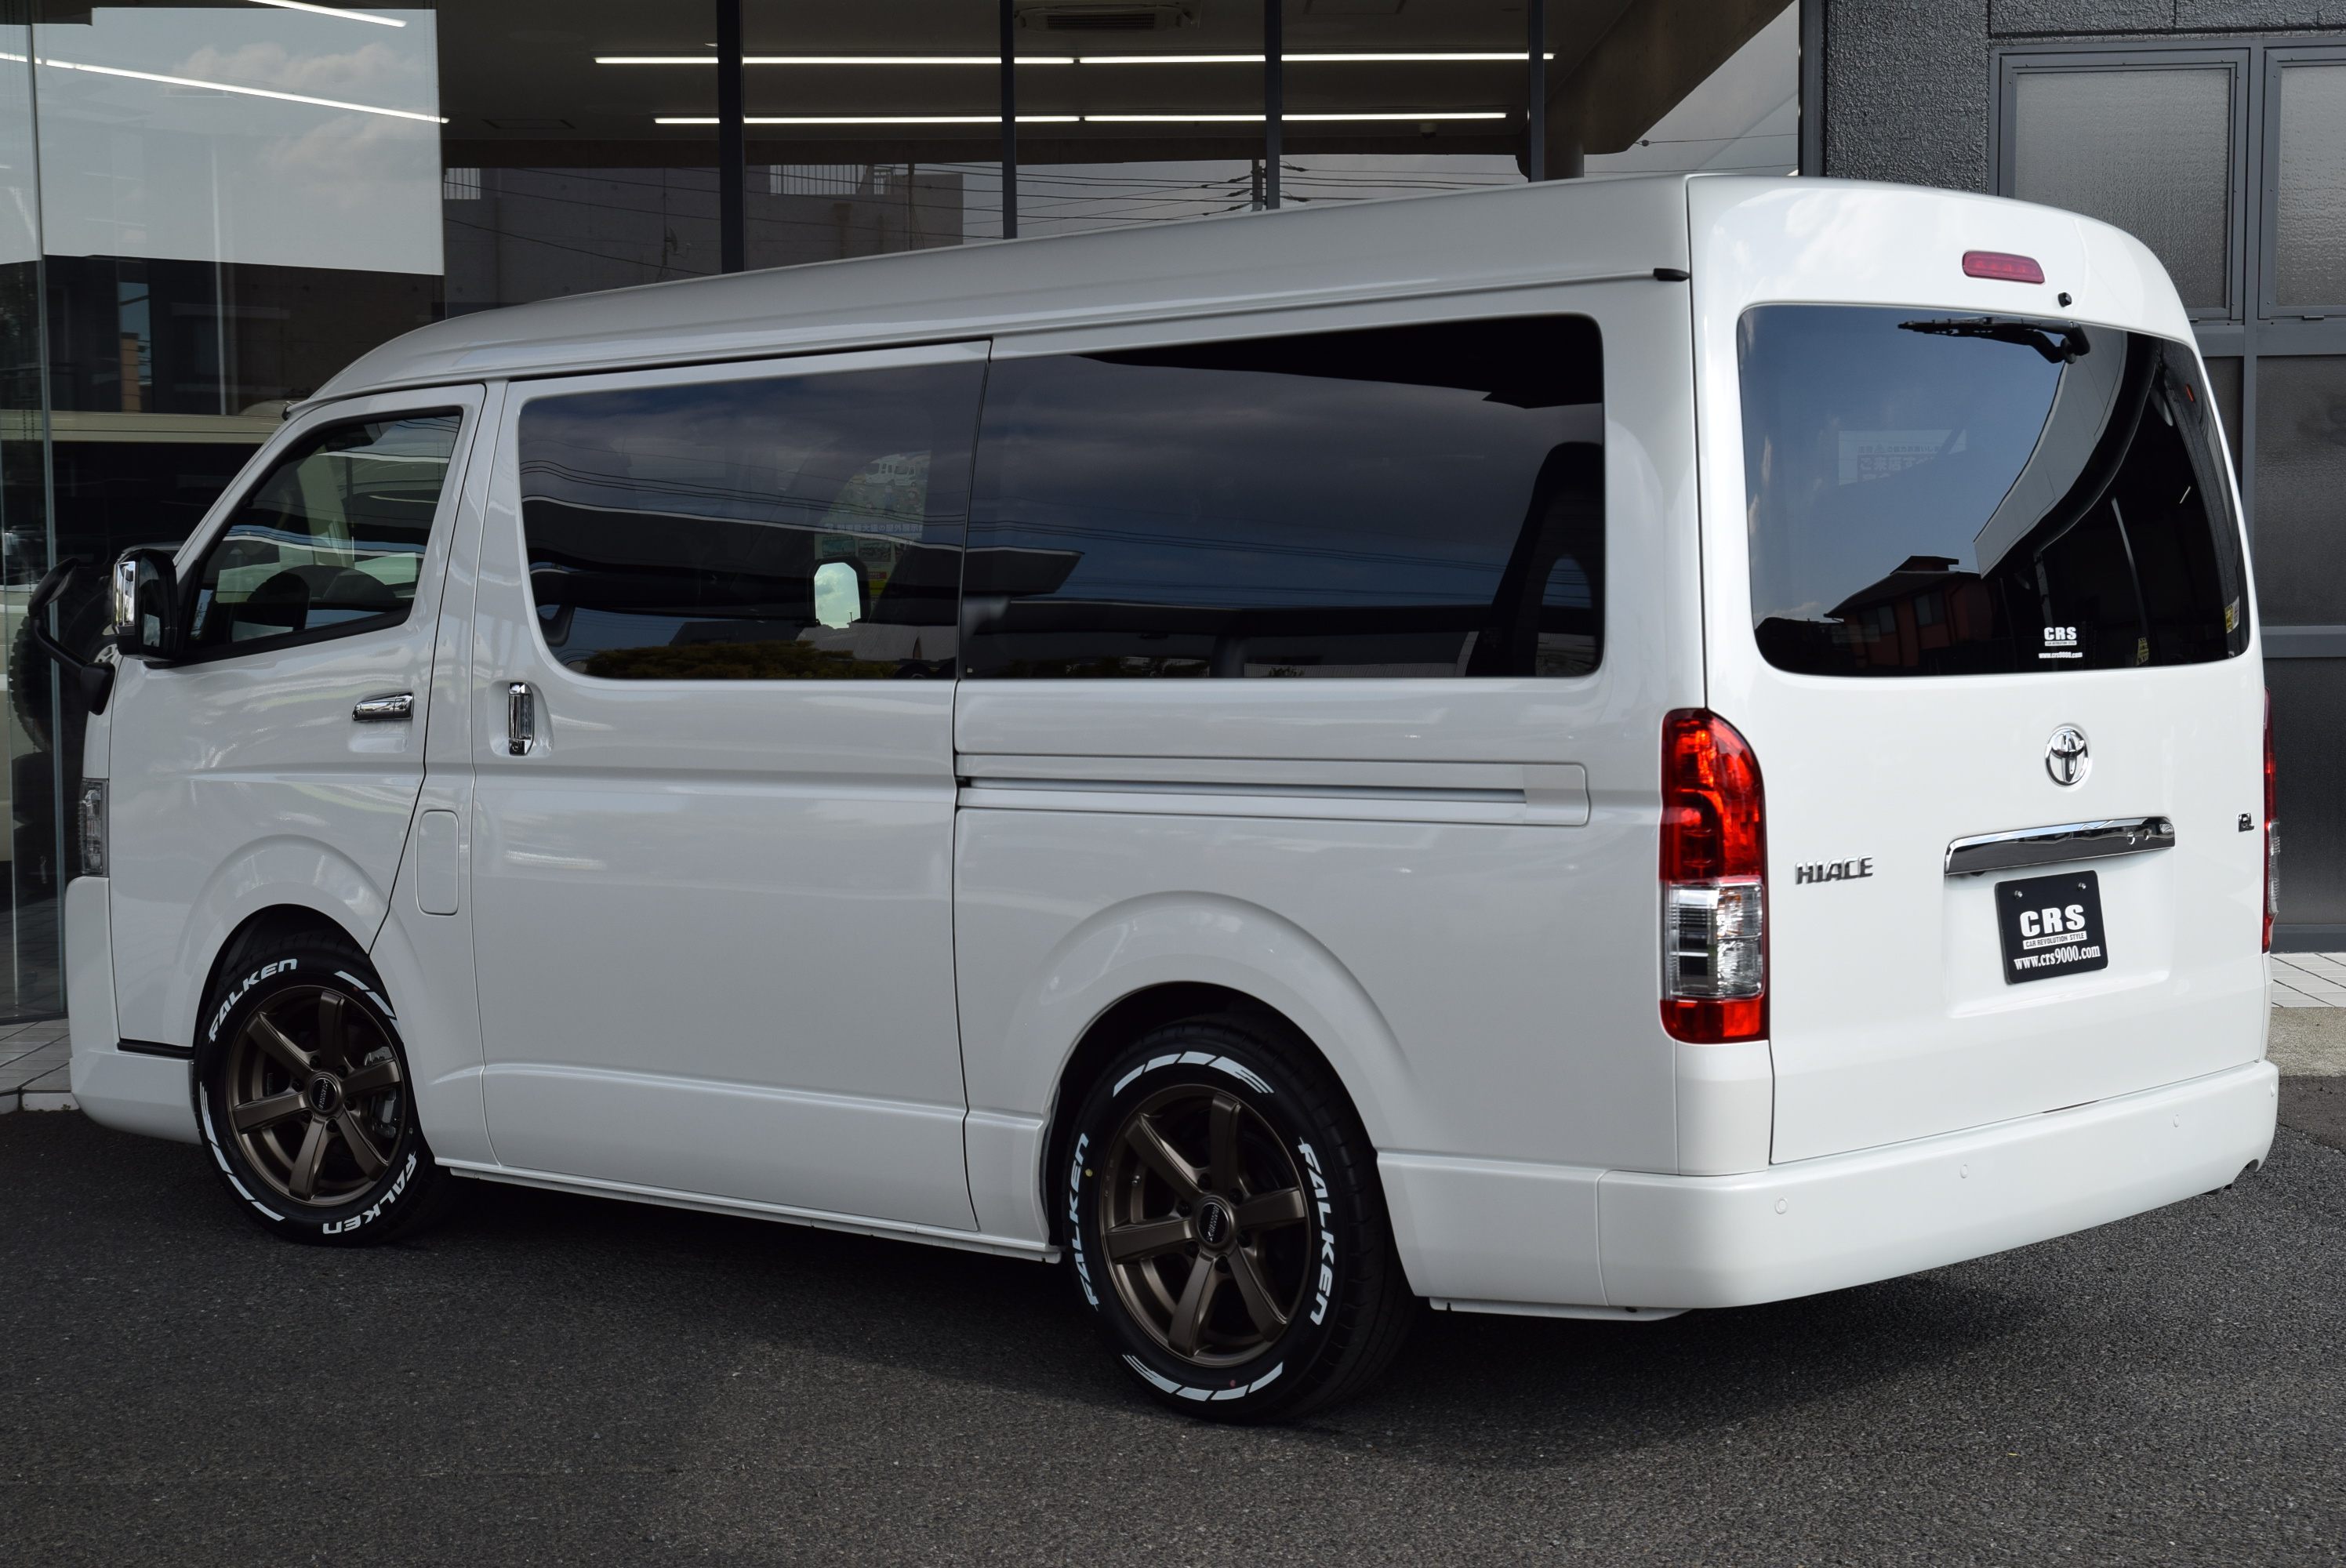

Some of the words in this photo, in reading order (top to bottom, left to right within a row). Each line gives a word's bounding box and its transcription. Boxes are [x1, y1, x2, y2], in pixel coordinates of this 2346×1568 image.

[2044, 626, 2077, 641] CRS
[1795, 856, 1873, 884] HIACE
[2020, 904, 2086, 937] CRS
[2025, 939, 2036, 948] CAR
[2037, 935, 2068, 946] REVOLUTION
[2070, 932, 2085, 941] STYLE
[2014, 946, 2101, 970] www.crs9000.com
[209, 958, 297, 1044] FALKEN
[322, 1150, 417, 1234] FALKEN
[1070, 1134, 1099, 1310] FALKEN
[1298, 1137, 1335, 1326] FALKEN
